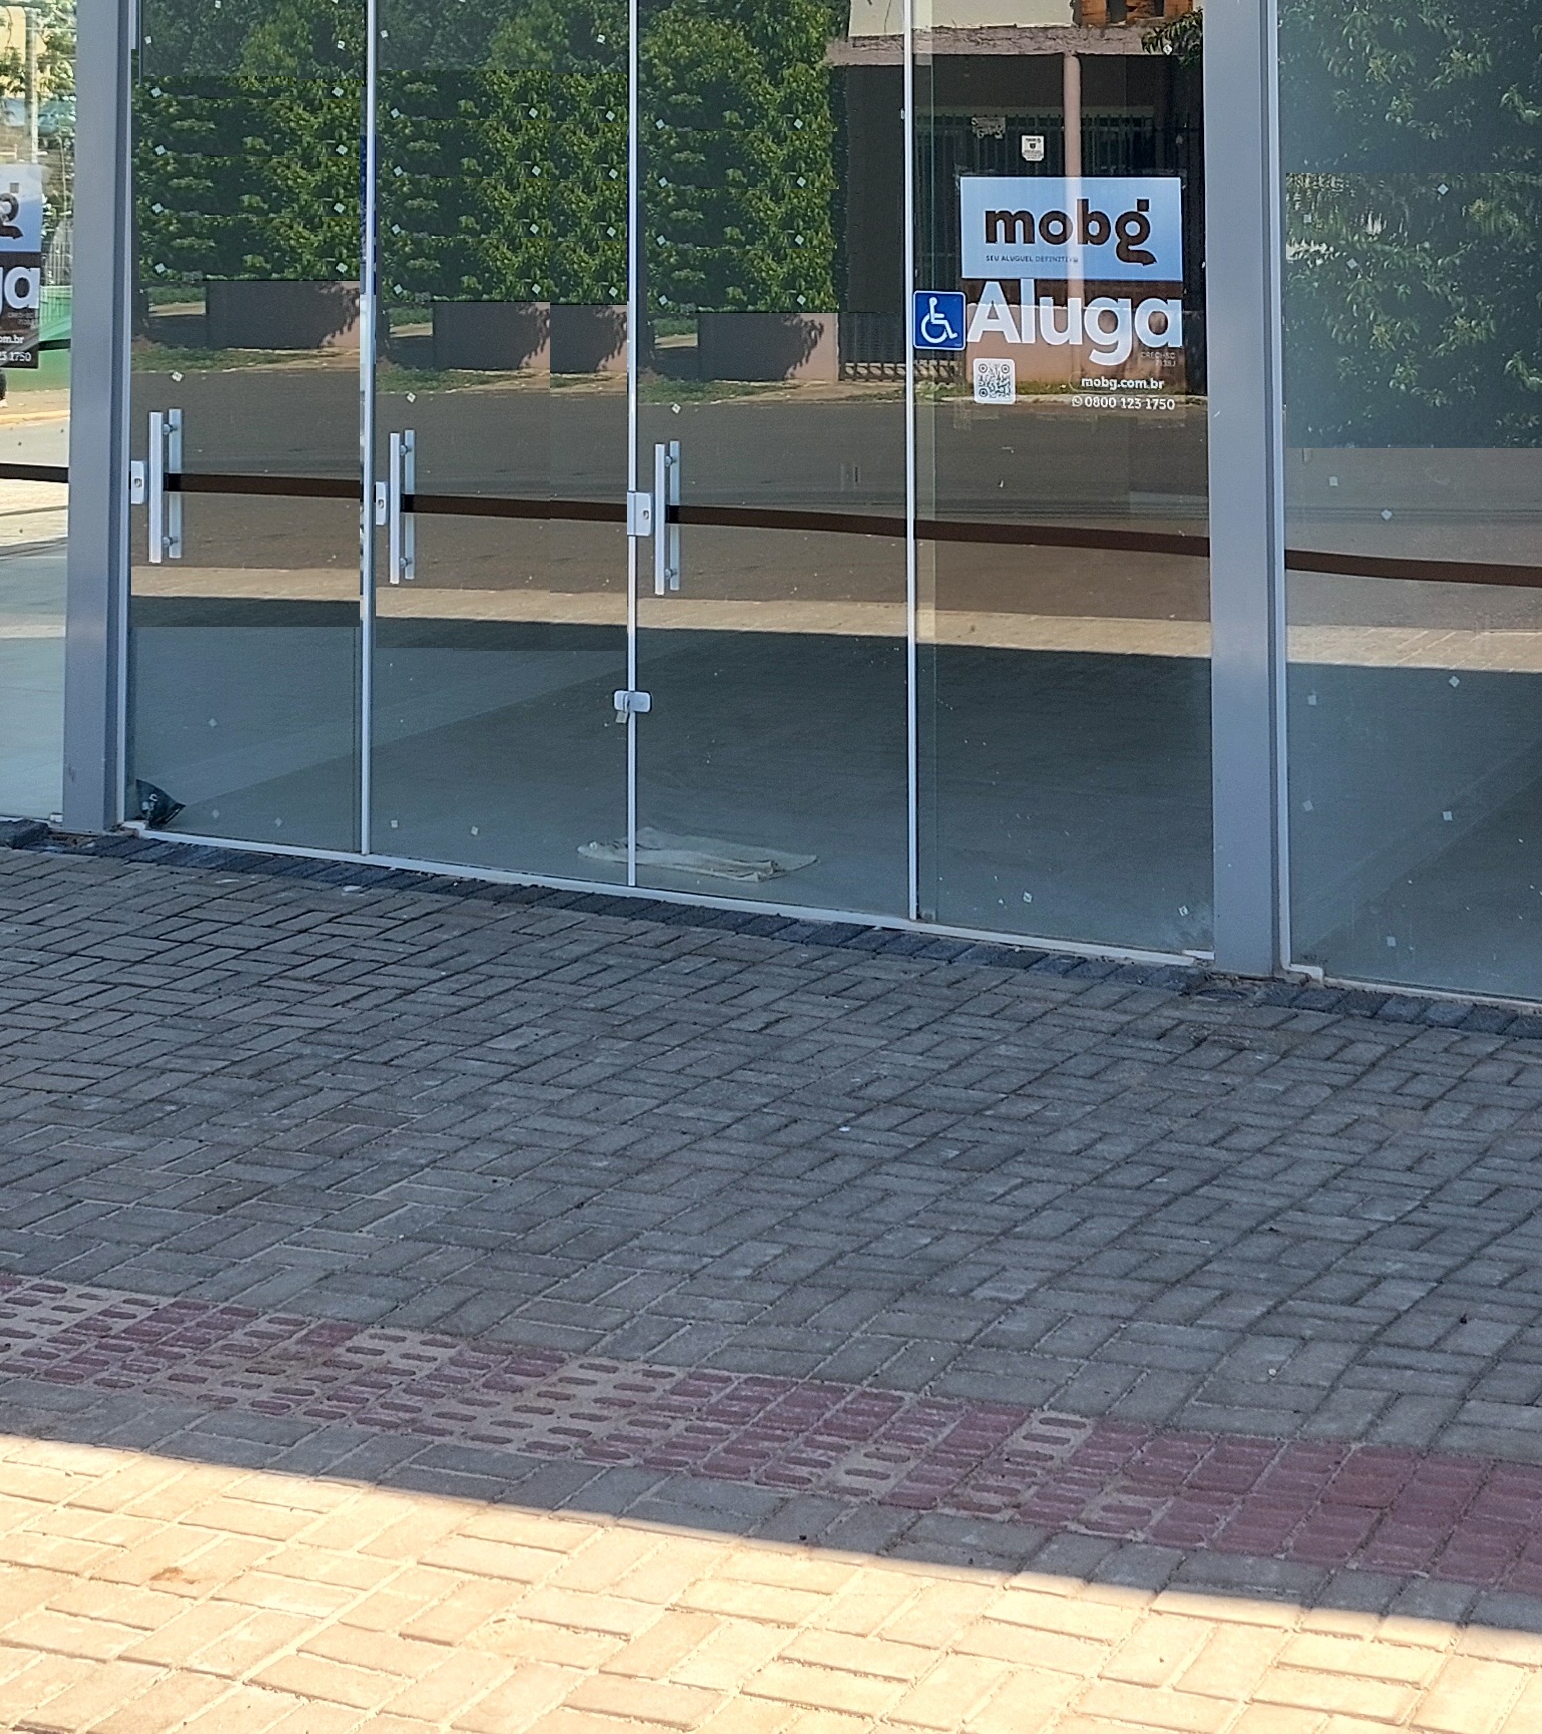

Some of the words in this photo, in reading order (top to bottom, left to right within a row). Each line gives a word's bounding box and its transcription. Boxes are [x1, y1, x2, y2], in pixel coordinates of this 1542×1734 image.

[984, 198, 1157, 266] mobg
[967, 278, 1183, 366] Aluga
[1081, 376, 1165, 391] mobg.com.br
[1084, 396, 1117, 409] 0800
[1120, 397, 1142, 409] 123
[1145, 398, 1176, 411] 1750
